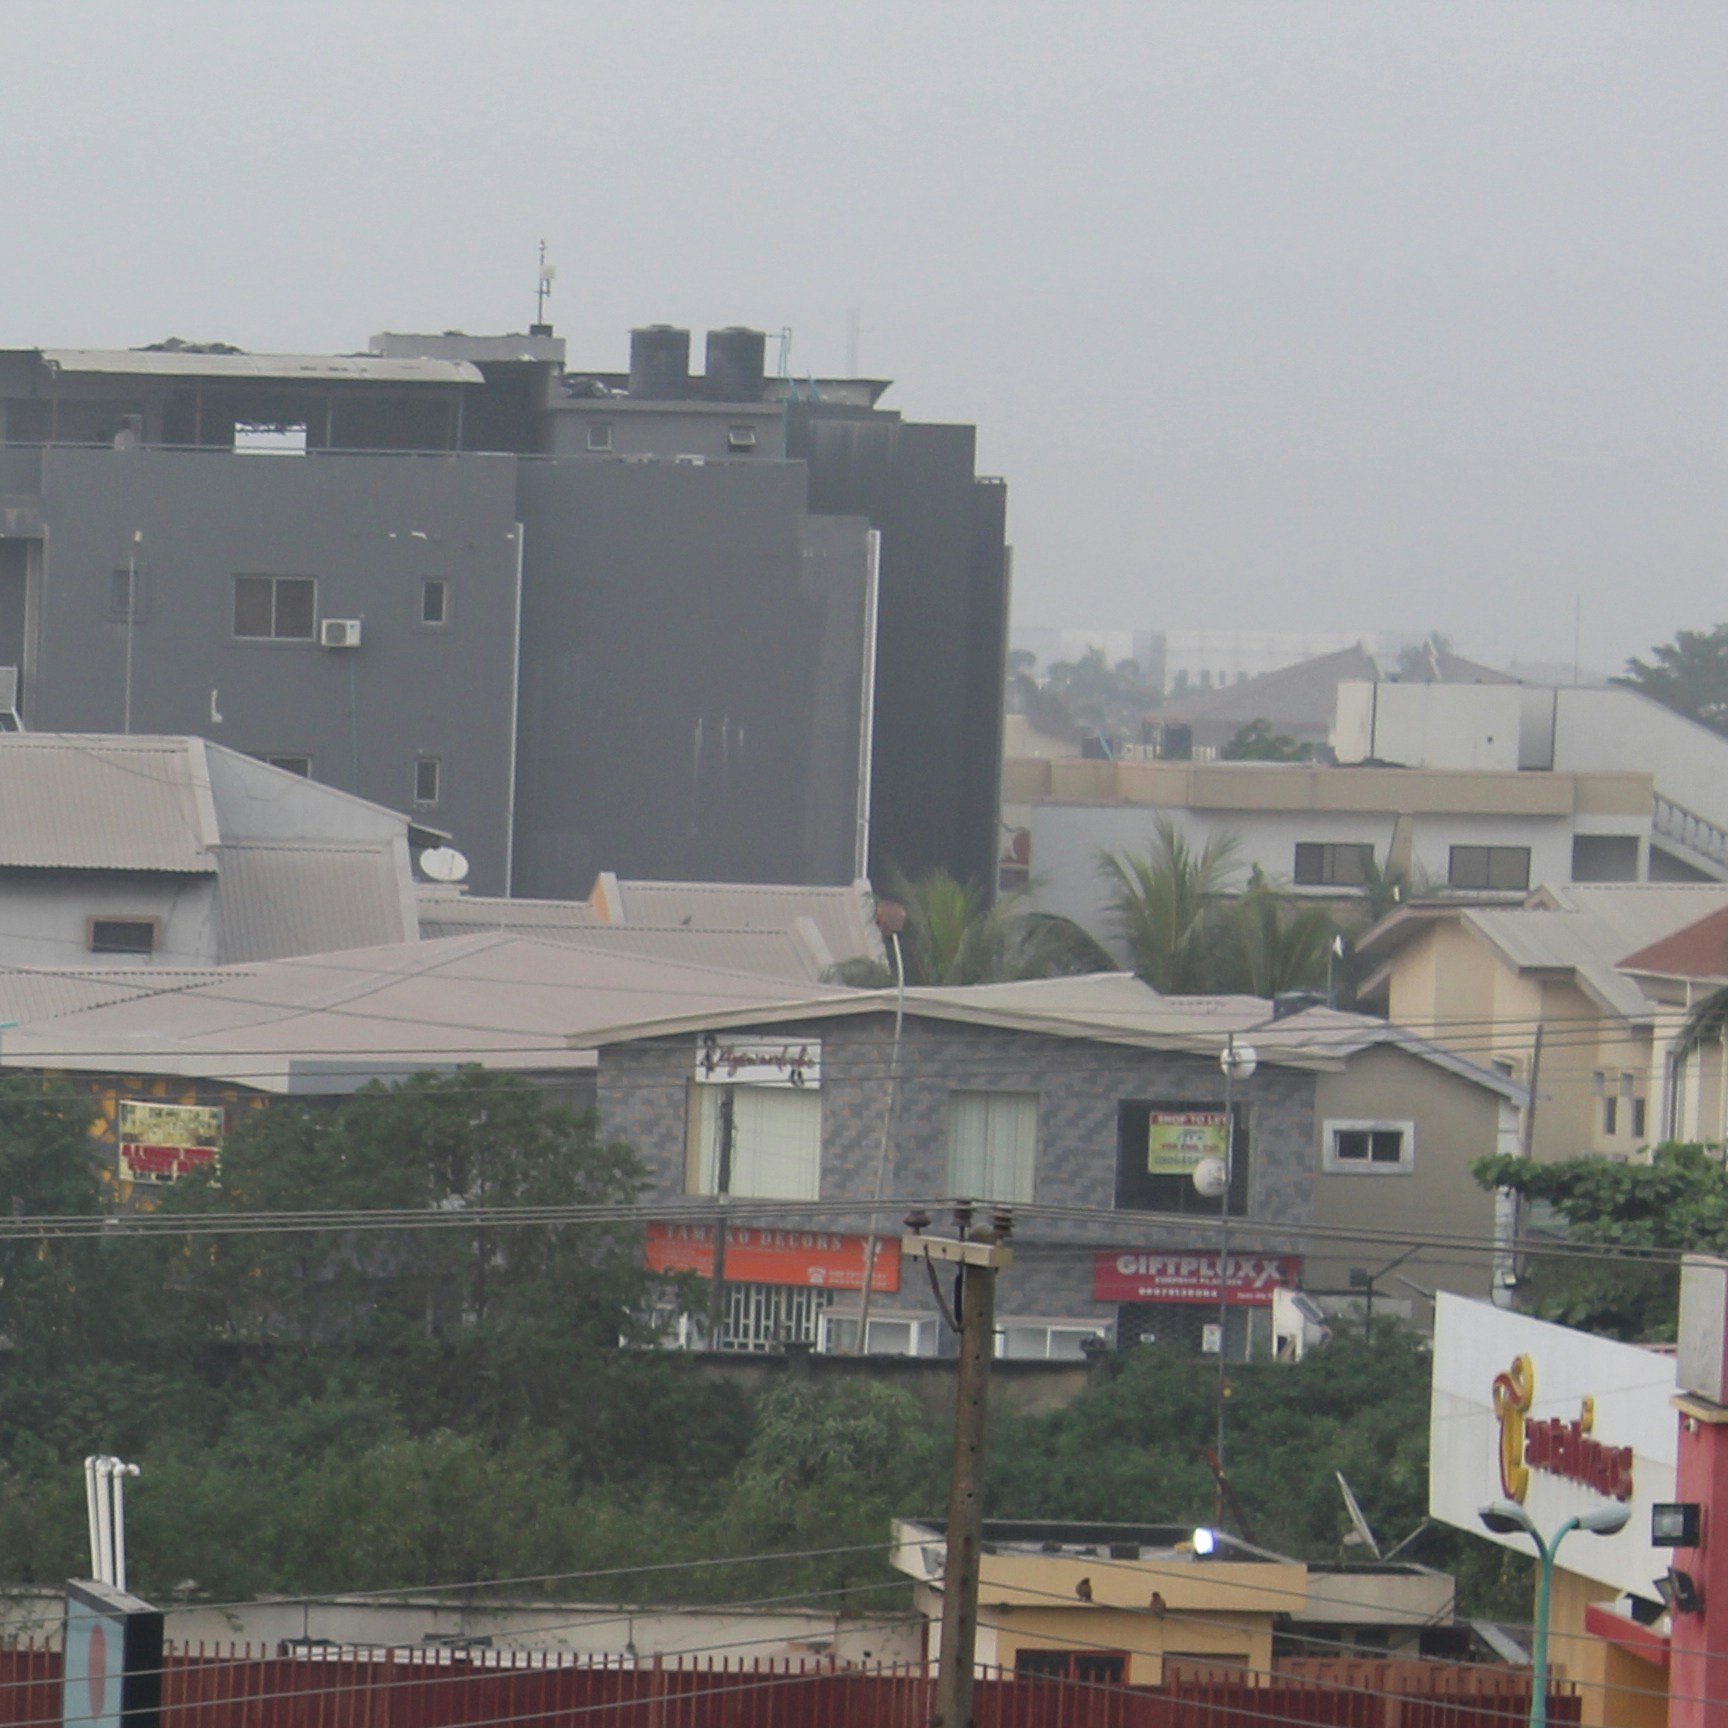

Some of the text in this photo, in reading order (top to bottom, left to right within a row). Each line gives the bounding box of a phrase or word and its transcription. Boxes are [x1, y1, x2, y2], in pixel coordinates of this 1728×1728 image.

[666, 1224, 842, 1250] TAMKO DECORS
[1116, 1255, 1281, 1288] GIFTPLUXX
[1200, 1278, 1242, 1287] PLANER
